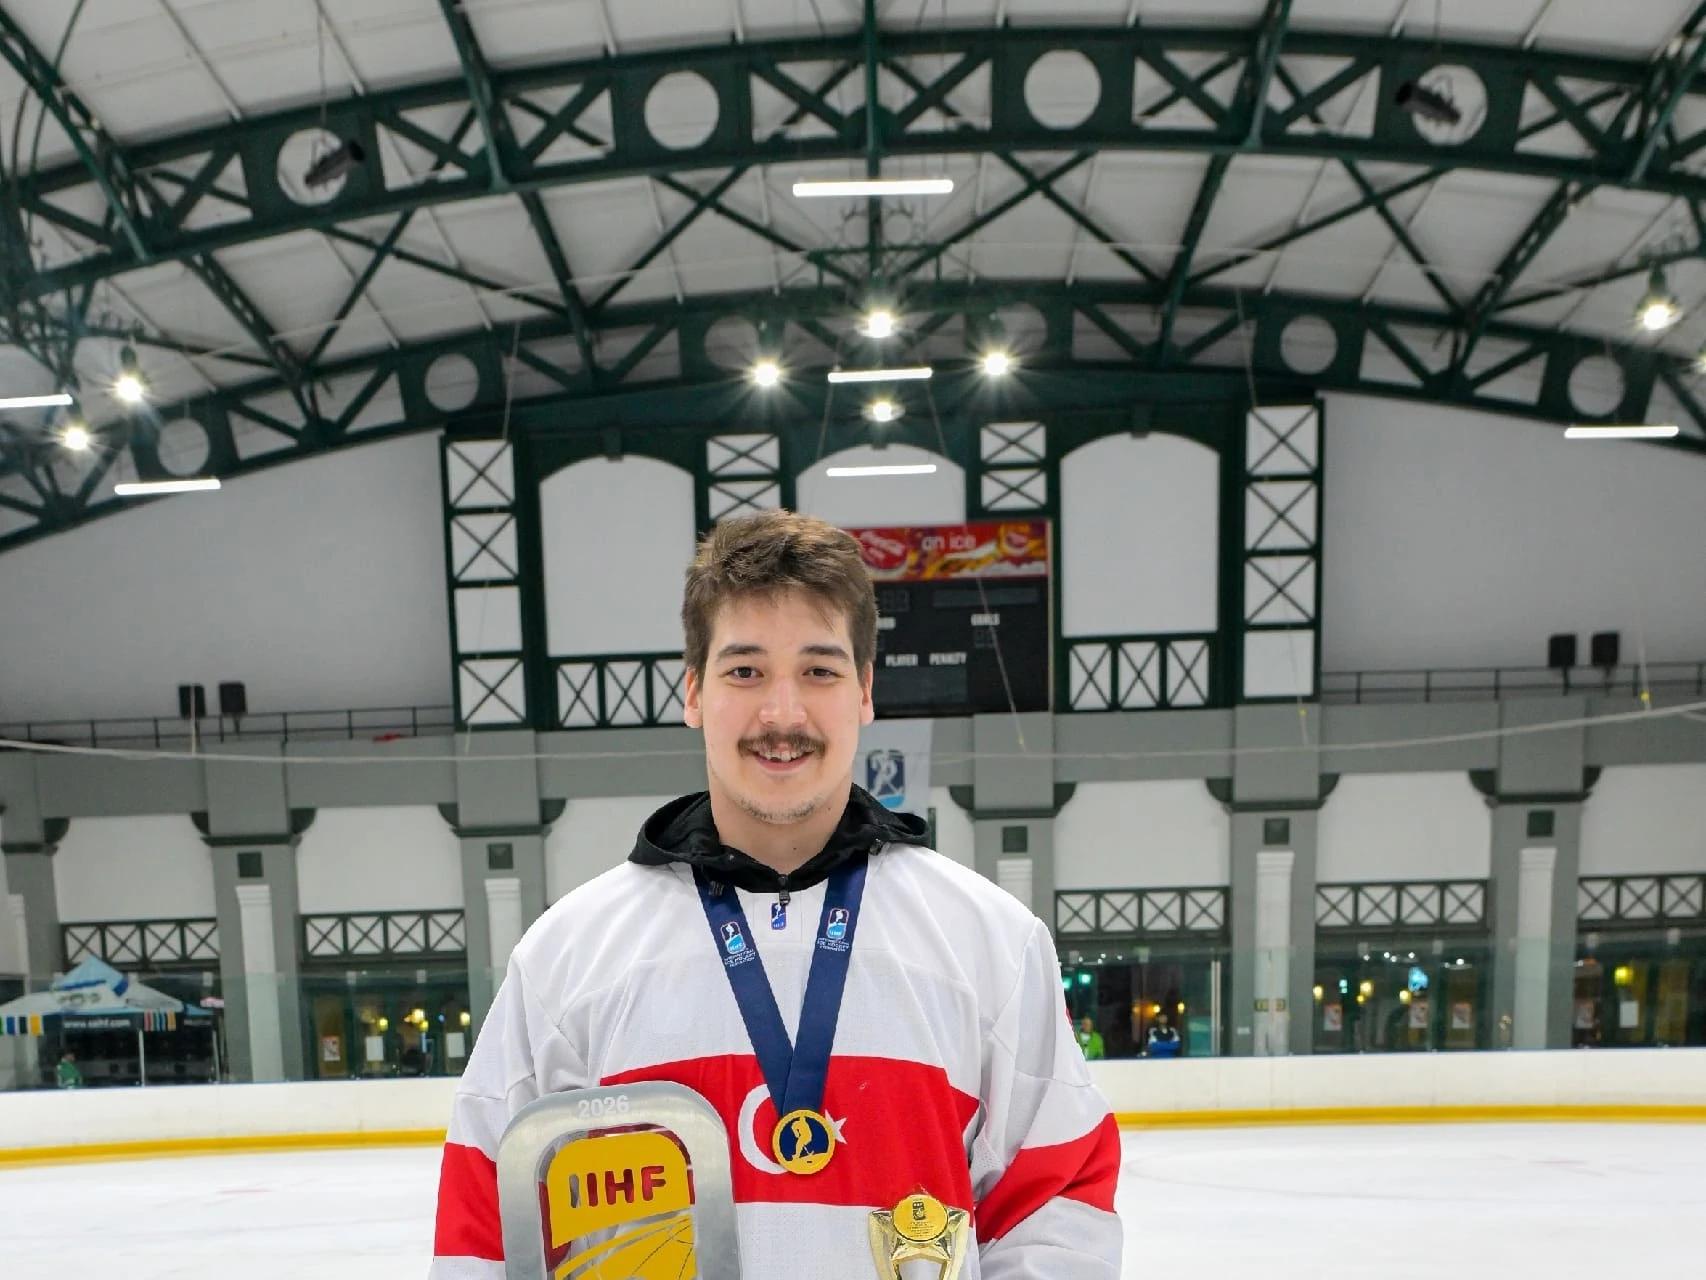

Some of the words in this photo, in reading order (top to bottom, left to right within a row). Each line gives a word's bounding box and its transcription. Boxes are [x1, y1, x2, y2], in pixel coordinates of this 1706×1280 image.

[922, 536, 944, 550] on
[950, 533, 976, 549] ice
[578, 1095, 629, 1117] 2026
[569, 1166, 666, 1208] IIHF
